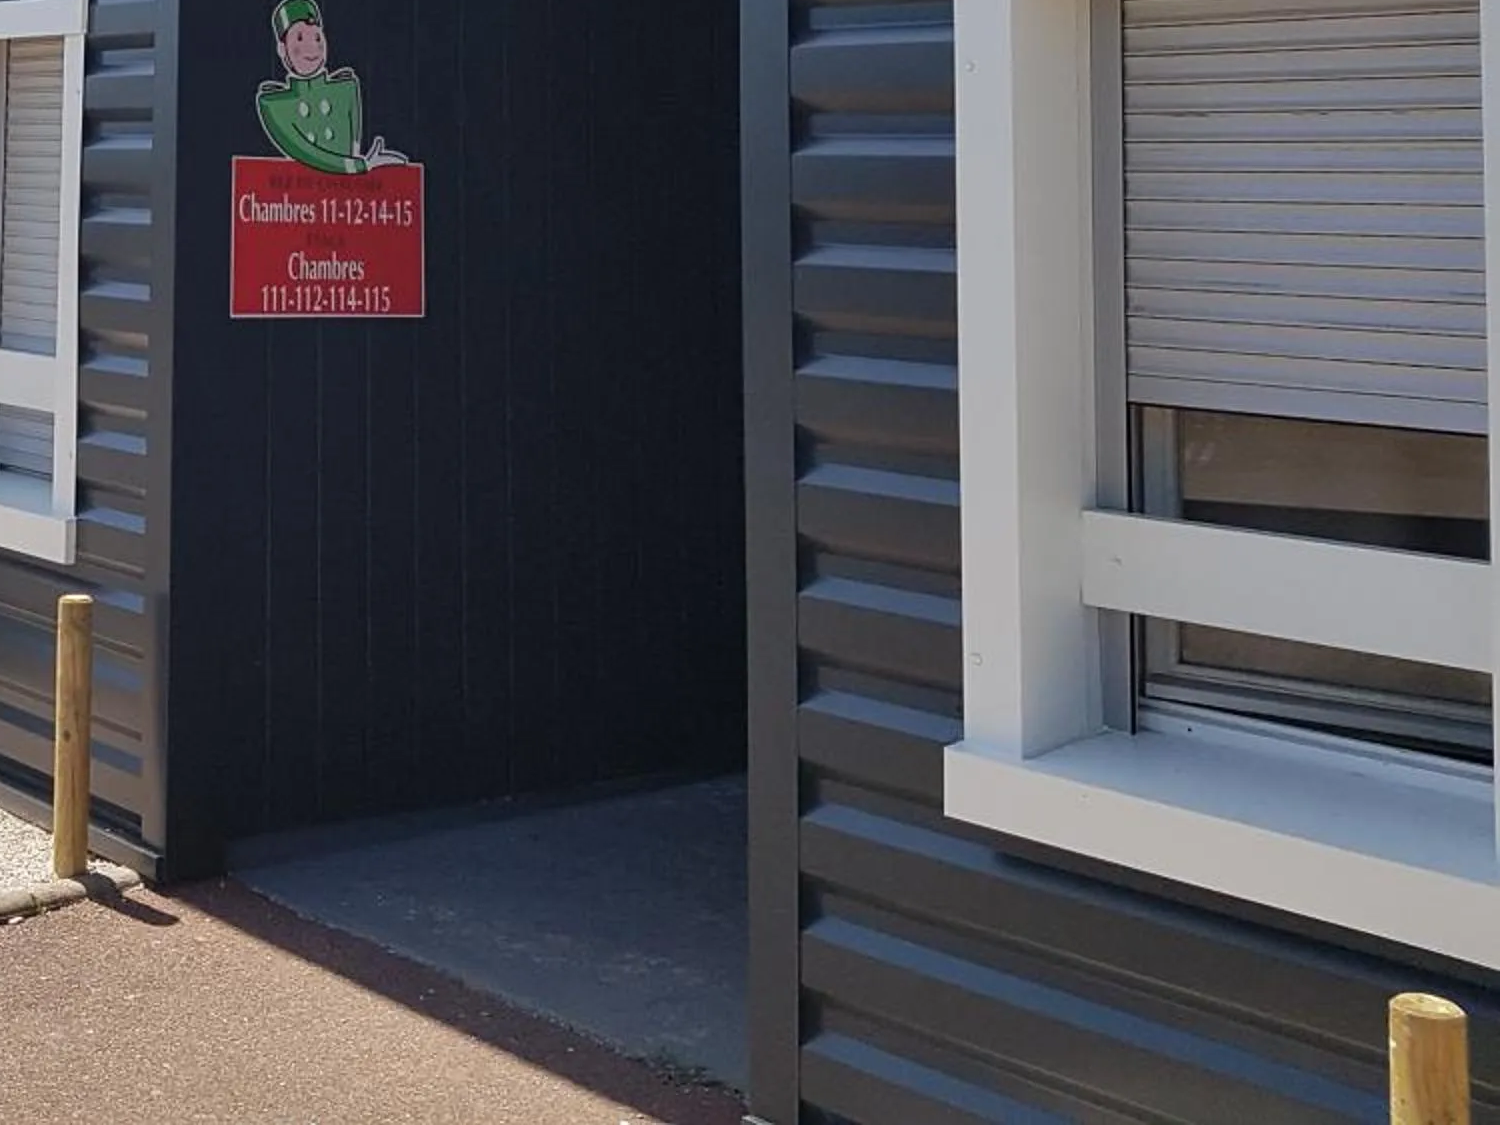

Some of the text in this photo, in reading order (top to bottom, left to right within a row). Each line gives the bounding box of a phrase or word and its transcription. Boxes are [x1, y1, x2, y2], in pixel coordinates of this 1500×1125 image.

[239, 192, 413, 226] Chambres 11-12-14-15
[287, 251, 365, 281] Chambres
[261, 284, 391, 312] 111-112-114-115
